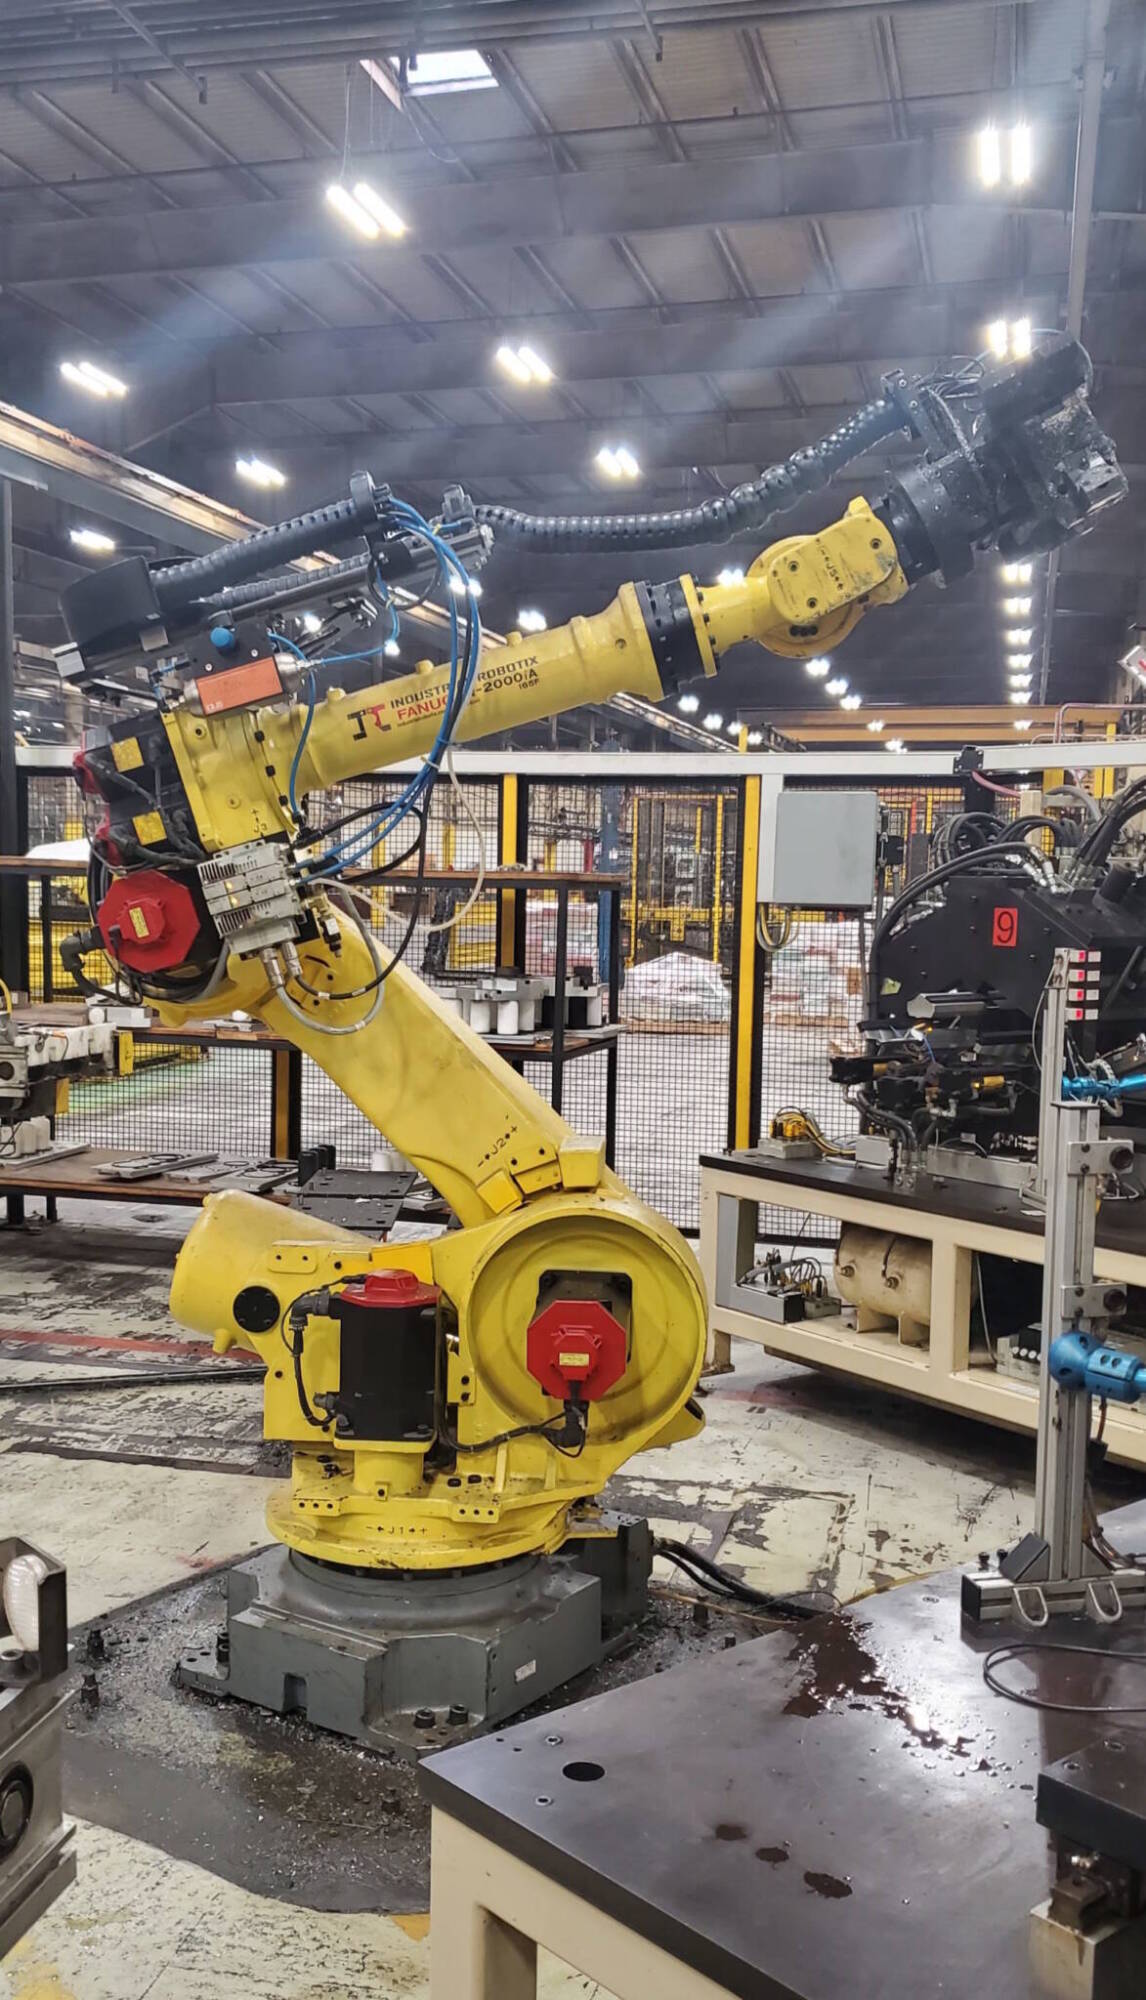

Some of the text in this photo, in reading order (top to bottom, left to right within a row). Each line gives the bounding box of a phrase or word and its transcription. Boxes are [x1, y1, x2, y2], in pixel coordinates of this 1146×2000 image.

[390, 656, 538, 709] INDUSTR ROBOTIX
[471, 668, 538, 697] -2000iA
[997, 911, 1014, 943] 9
